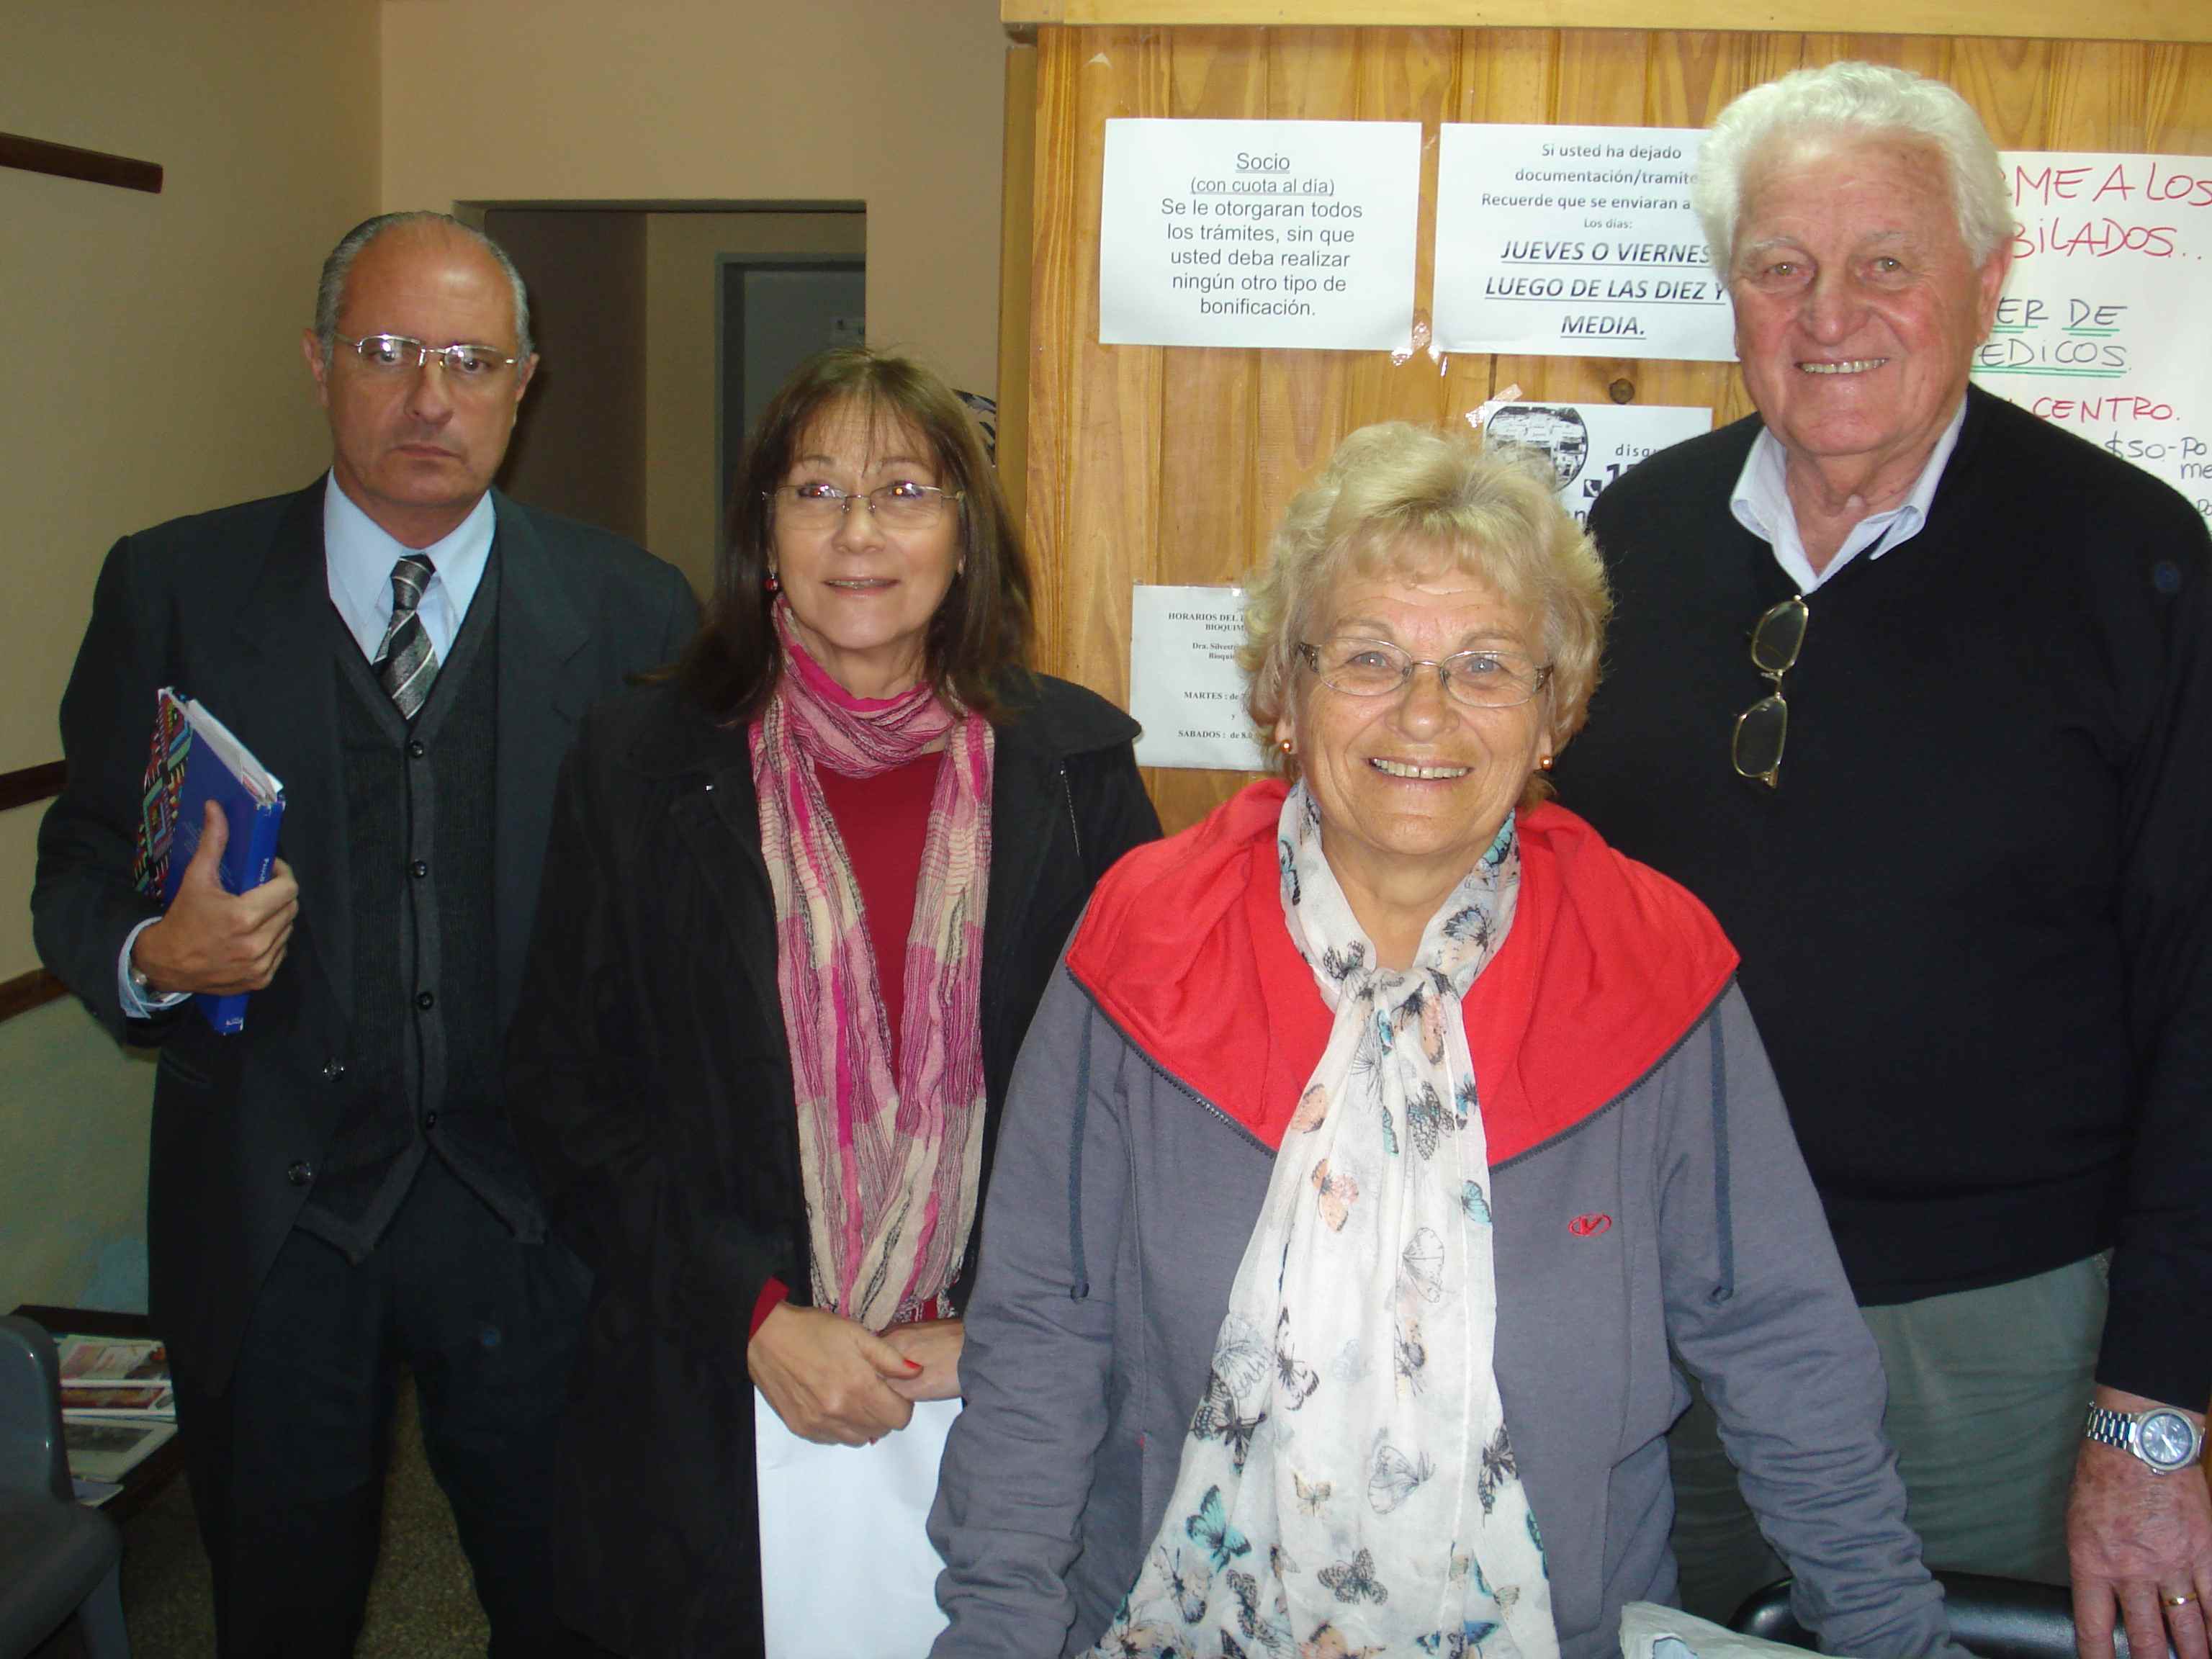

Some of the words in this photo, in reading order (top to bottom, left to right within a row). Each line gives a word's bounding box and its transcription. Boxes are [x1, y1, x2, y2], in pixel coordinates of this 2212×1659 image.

[1236, 153, 1290, 171] Socio
[1542, 144, 1555, 157] Si
[1559, 145, 1601, 158] usted
[1606, 145, 1624, 158] ha
[1629, 145, 1682, 161] dejado
[1190, 177, 1226, 194] (con
[1232, 179, 1277, 192] cuota
[1282, 179, 1297, 192] al
[1302, 178, 1335, 195] día)
[2007, 165, 2092, 207] ME
[2092, 163, 2135, 202] A
[2146, 162, 2212, 206] LOS
[1161, 198, 1186, 215] Se
[1192, 199, 1208, 215] le
[1215, 202, 1304, 220] otorgaran
[1311, 202, 1363, 217] todos
[1481, 193, 1552, 207] Recuerde
[1557, 196, 1586, 210] que
[1591, 197, 1606, 208] se
[1611, 197, 1678, 210] enviaran
[1682, 199, 1690, 210] a
[1583, 219, 1602, 228] Los
[1606, 219, 1632, 229] días:
[1167, 224, 1193, 240] los
[1200, 225, 1280, 243] trámites,
[1287, 226, 1313, 242] sin
[1320, 229, 1354, 246] que
[1170, 249, 1221, 264] usted
[1228, 251, 1274, 266] deba
[1280, 251, 1350, 267] realizar
[1501, 240, 1584, 260] JUEVES
[1591, 243, 1608, 260] O
[1617, 243, 1709, 264] VIERNES
[1172, 273, 1235, 293] ningún
[1241, 276, 1277, 290] otro
[1283, 275, 1316, 295] tipo
[1323, 276, 1346, 292] de
[1485, 276, 1563, 297] LUEGO
[1570, 279, 1599, 297] DE
[1606, 280, 1647, 299] LAS
[1655, 282, 1707, 300] DIEZ
[1714, 282, 1725, 300] Y
[1200, 298, 1316, 316] bonificación.
[1996, 297, 2049, 327] ER
[2069, 299, 2127, 327] DE
[1561, 315, 1645, 335] MEDIA.
